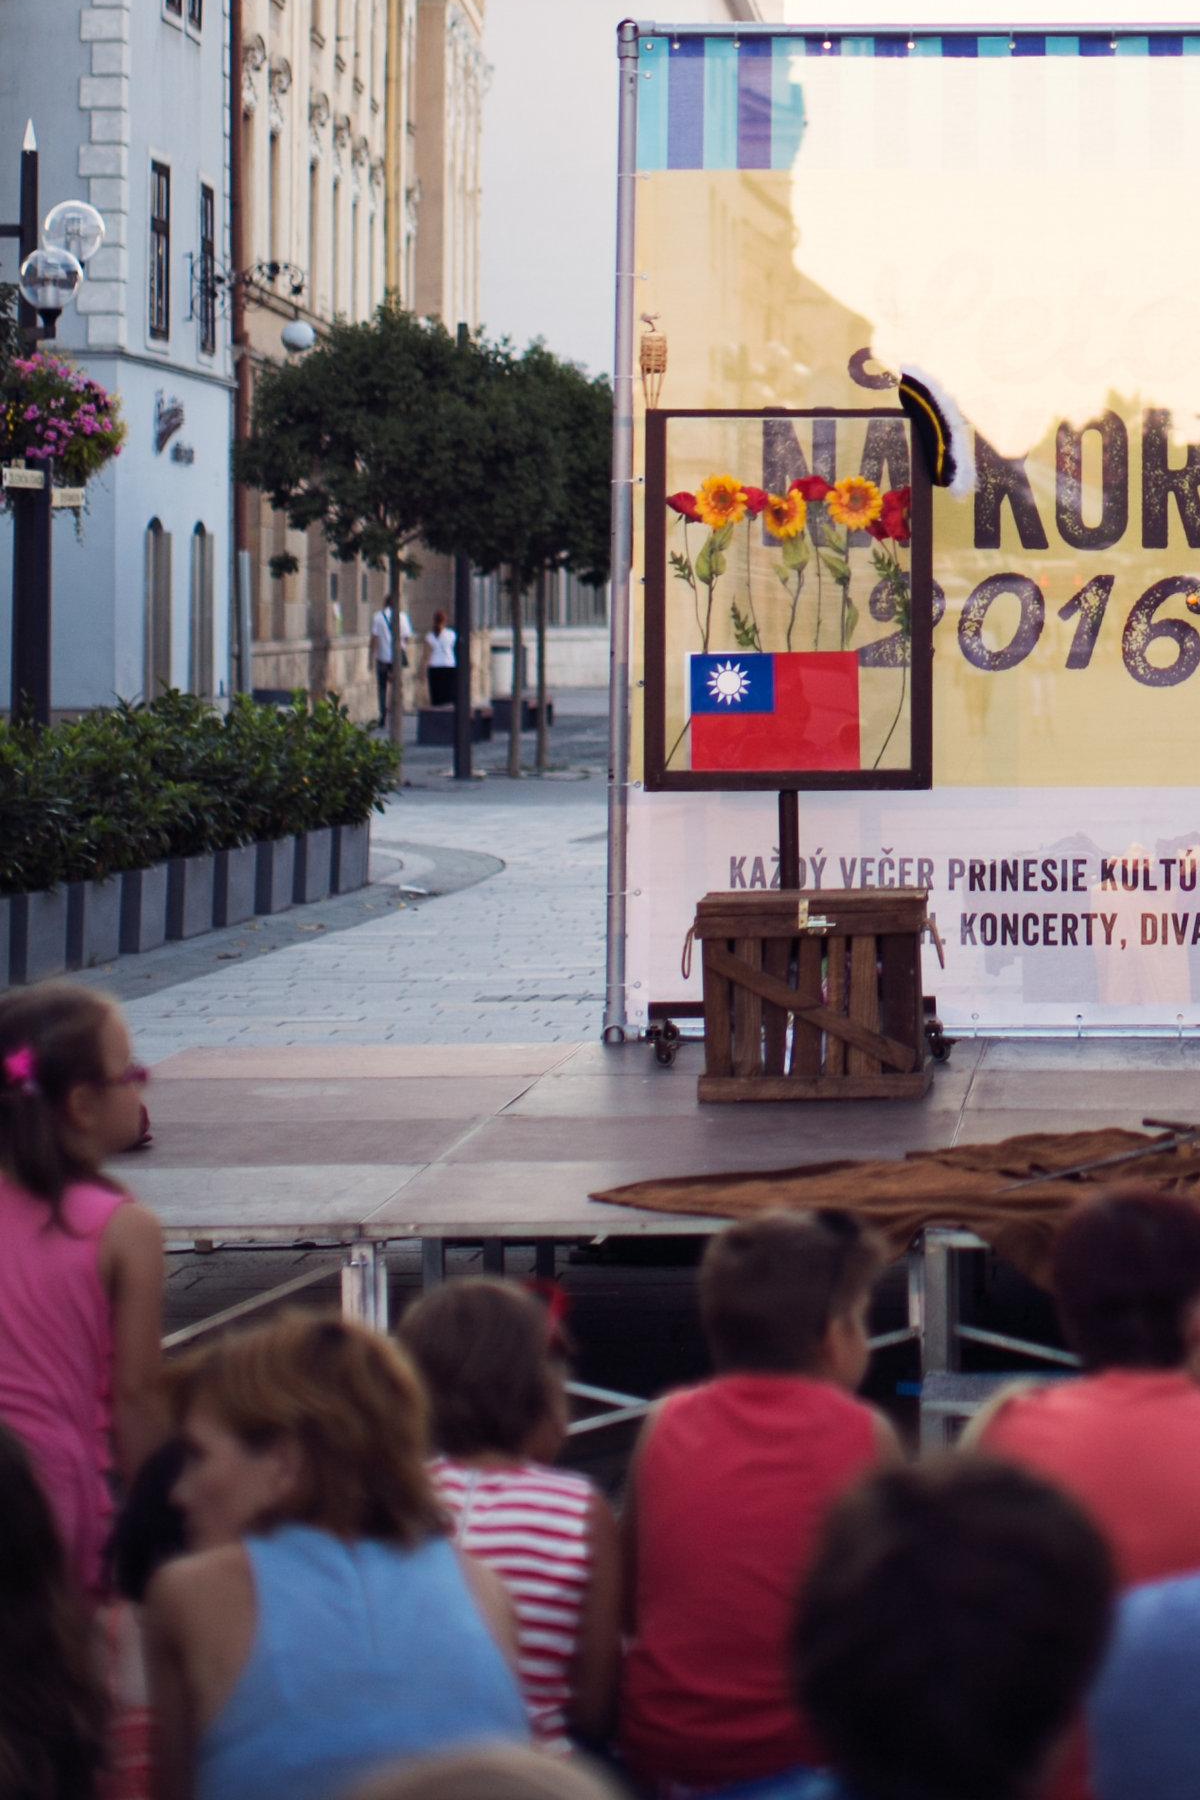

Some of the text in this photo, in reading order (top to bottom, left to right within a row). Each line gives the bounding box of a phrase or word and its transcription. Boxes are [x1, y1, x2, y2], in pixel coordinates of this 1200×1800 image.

[839, 847, 934, 890] VEČER
[948, 858, 1088, 892] PRINESIE
[960, 912, 1128, 950] KONCERTY,
